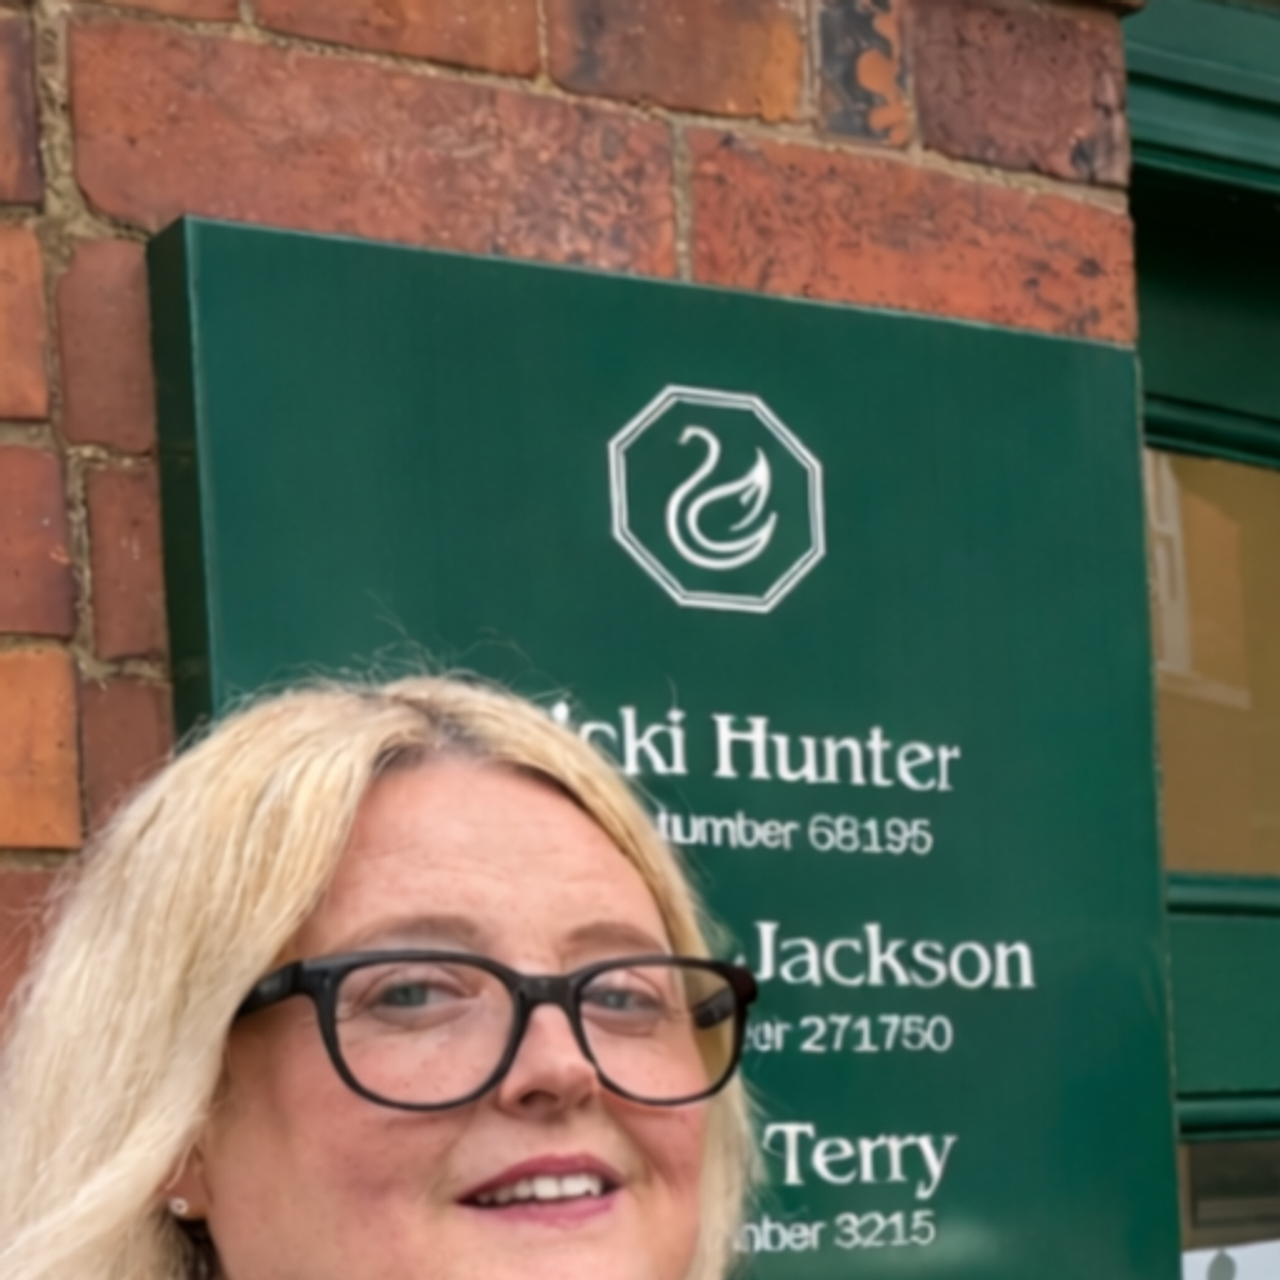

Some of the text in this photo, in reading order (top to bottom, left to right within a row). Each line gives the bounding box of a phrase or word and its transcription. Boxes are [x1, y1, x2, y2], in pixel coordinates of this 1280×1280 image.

[712, 713, 960, 792] Hunter
[808, 813, 933, 856] 68195
[754, 920, 1036, 989] Jackson
[799, 1013, 953, 1053] 271750
[762, 1121, 958, 1201] Terry
[833, 1209, 936, 1250] 3215
